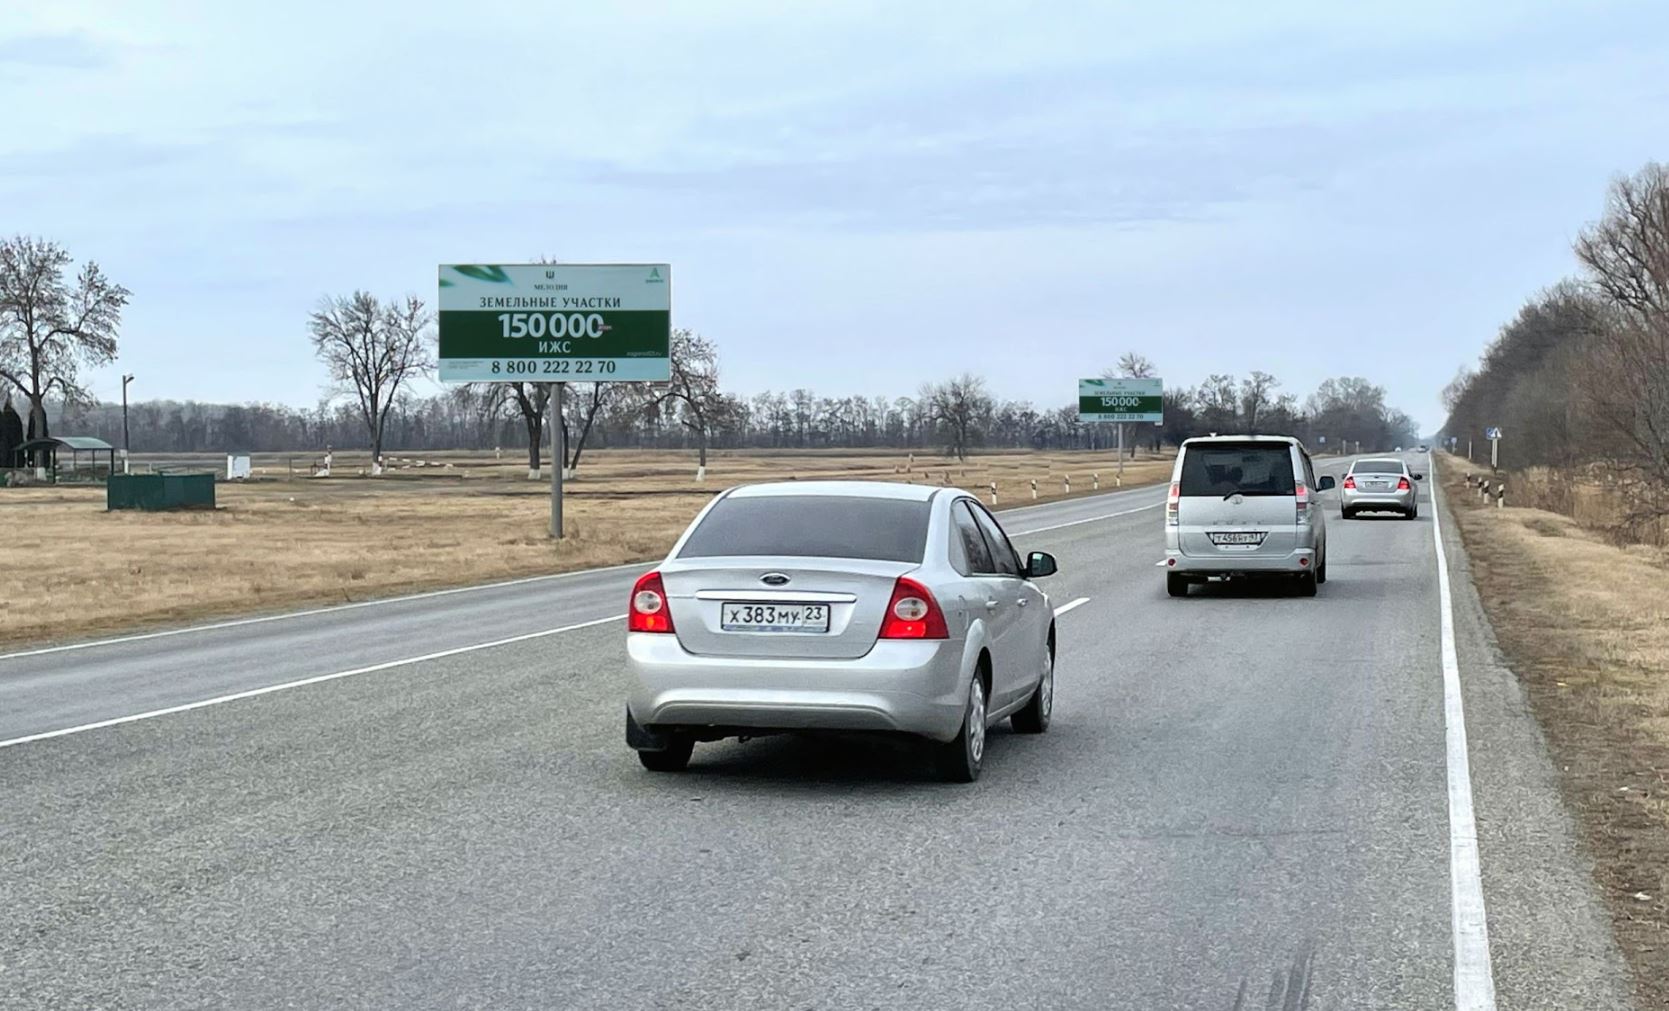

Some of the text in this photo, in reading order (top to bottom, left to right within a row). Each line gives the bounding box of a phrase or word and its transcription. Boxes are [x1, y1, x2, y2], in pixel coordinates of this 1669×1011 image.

[480, 297, 621, 308] ЗЕМЕЛЬНЫЕ УЧАСТКИ
[498, 313, 604, 338] 150 000
[538, 341, 572, 353] ИЖС
[491, 360, 501, 374] 8
[506, 360, 537, 374] 800
[543, 360, 569, 374] 222
[575, 360, 592, 374] 22
[598, 360, 616, 374] 70
[1100, 397, 1139, 407] 150 000
[805, 607, 822, 620] 23
